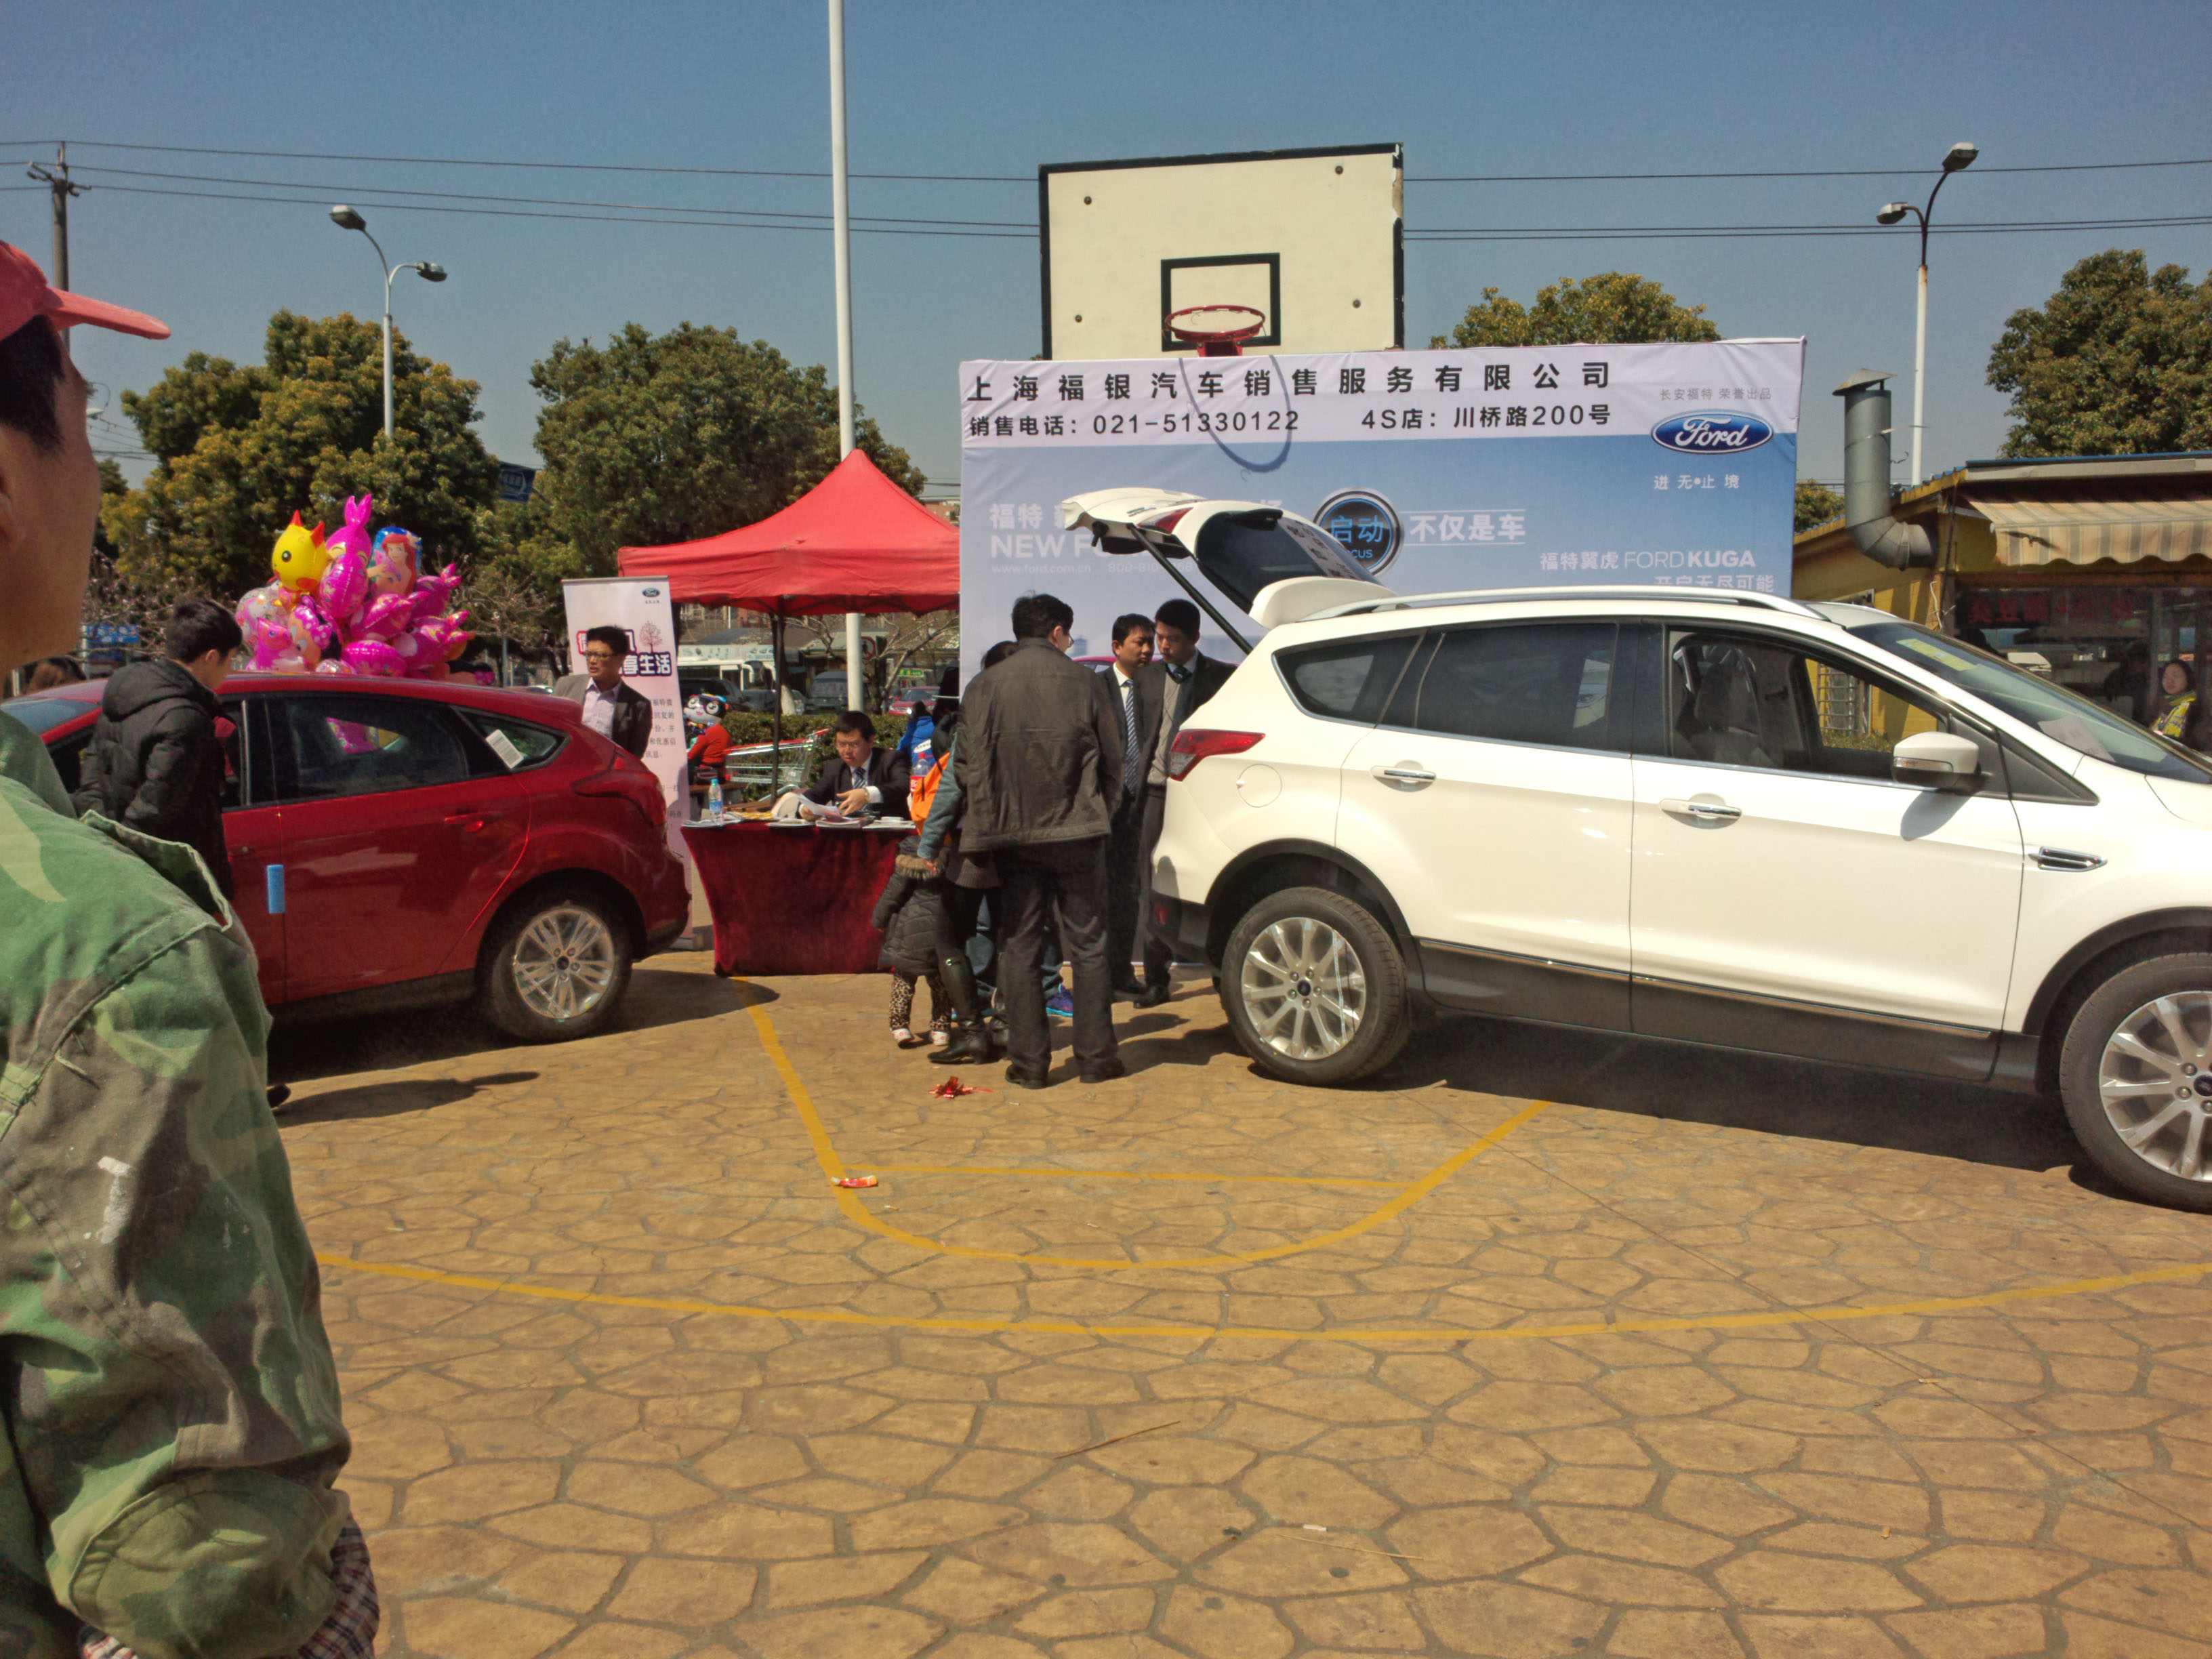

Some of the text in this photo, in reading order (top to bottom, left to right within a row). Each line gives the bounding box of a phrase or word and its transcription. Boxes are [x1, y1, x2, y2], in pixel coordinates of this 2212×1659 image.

[967, 362, 1609, 401] 上海福银汽车销售服务有限公司
[1660, 388, 1771, 401] 长安福特 荣誉出品
[970, 404, 1611, 436] 销售电话：021-51330122 4S店：川桥路200号
[1675, 416, 1750, 446] Ford
[1330, 516, 1384, 544] 启动
[1409, 513, 1525, 541] 不仅是车
[991, 534, 1066, 558] NEW
[1540, 550, 1756, 571] 福特翼虎 FORD KUGA
